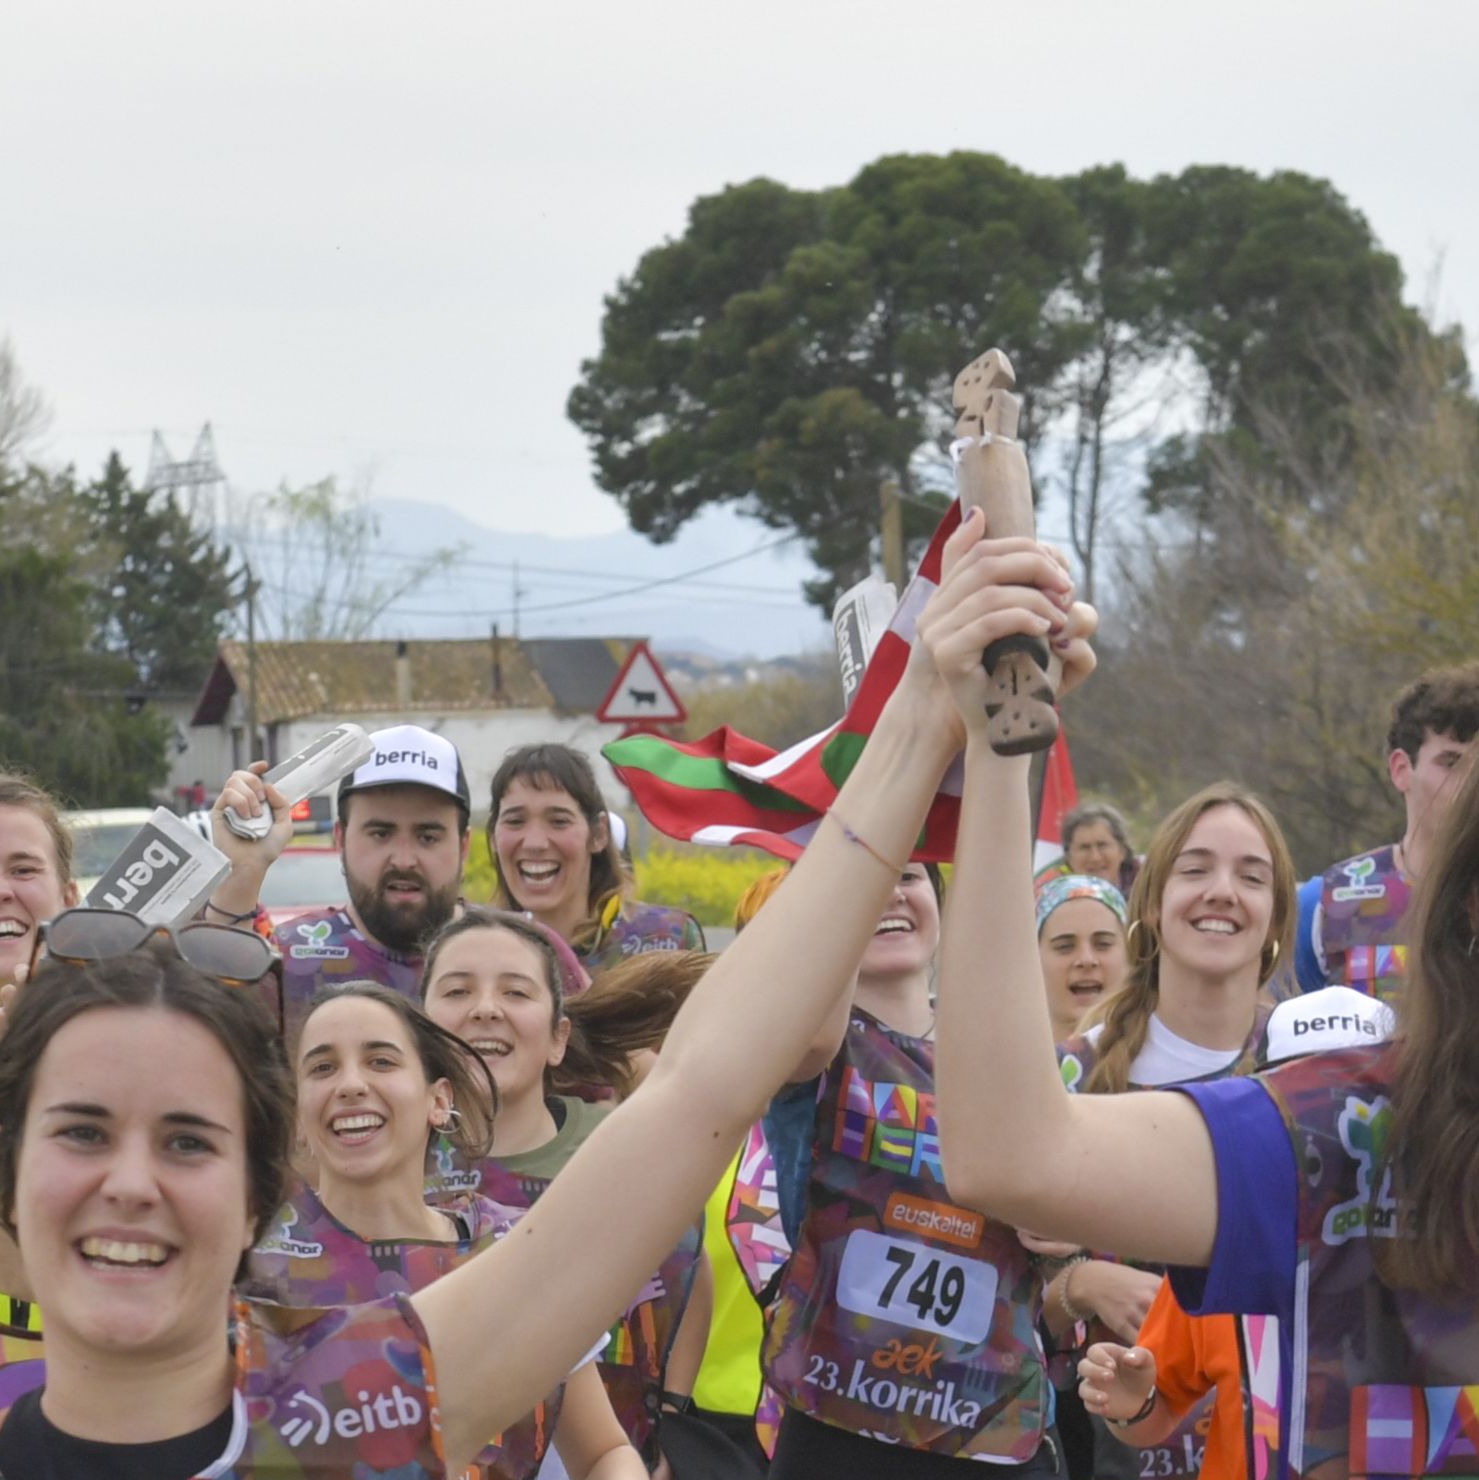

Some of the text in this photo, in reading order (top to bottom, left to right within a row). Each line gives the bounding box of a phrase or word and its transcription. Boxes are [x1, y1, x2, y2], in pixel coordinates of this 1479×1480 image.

[836, 608, 863, 695] berria
[374, 749, 439, 771] berria
[103, 839, 180, 910] berr
[1293, 1013, 1378, 1037] berria
[891, 1203, 977, 1241] euskaltel
[876, 1245, 966, 1328] 749
[871, 1335, 943, 1381] aek
[333, 1386, 423, 1440] eitb
[802, 1354, 982, 1430] 23.korrika
